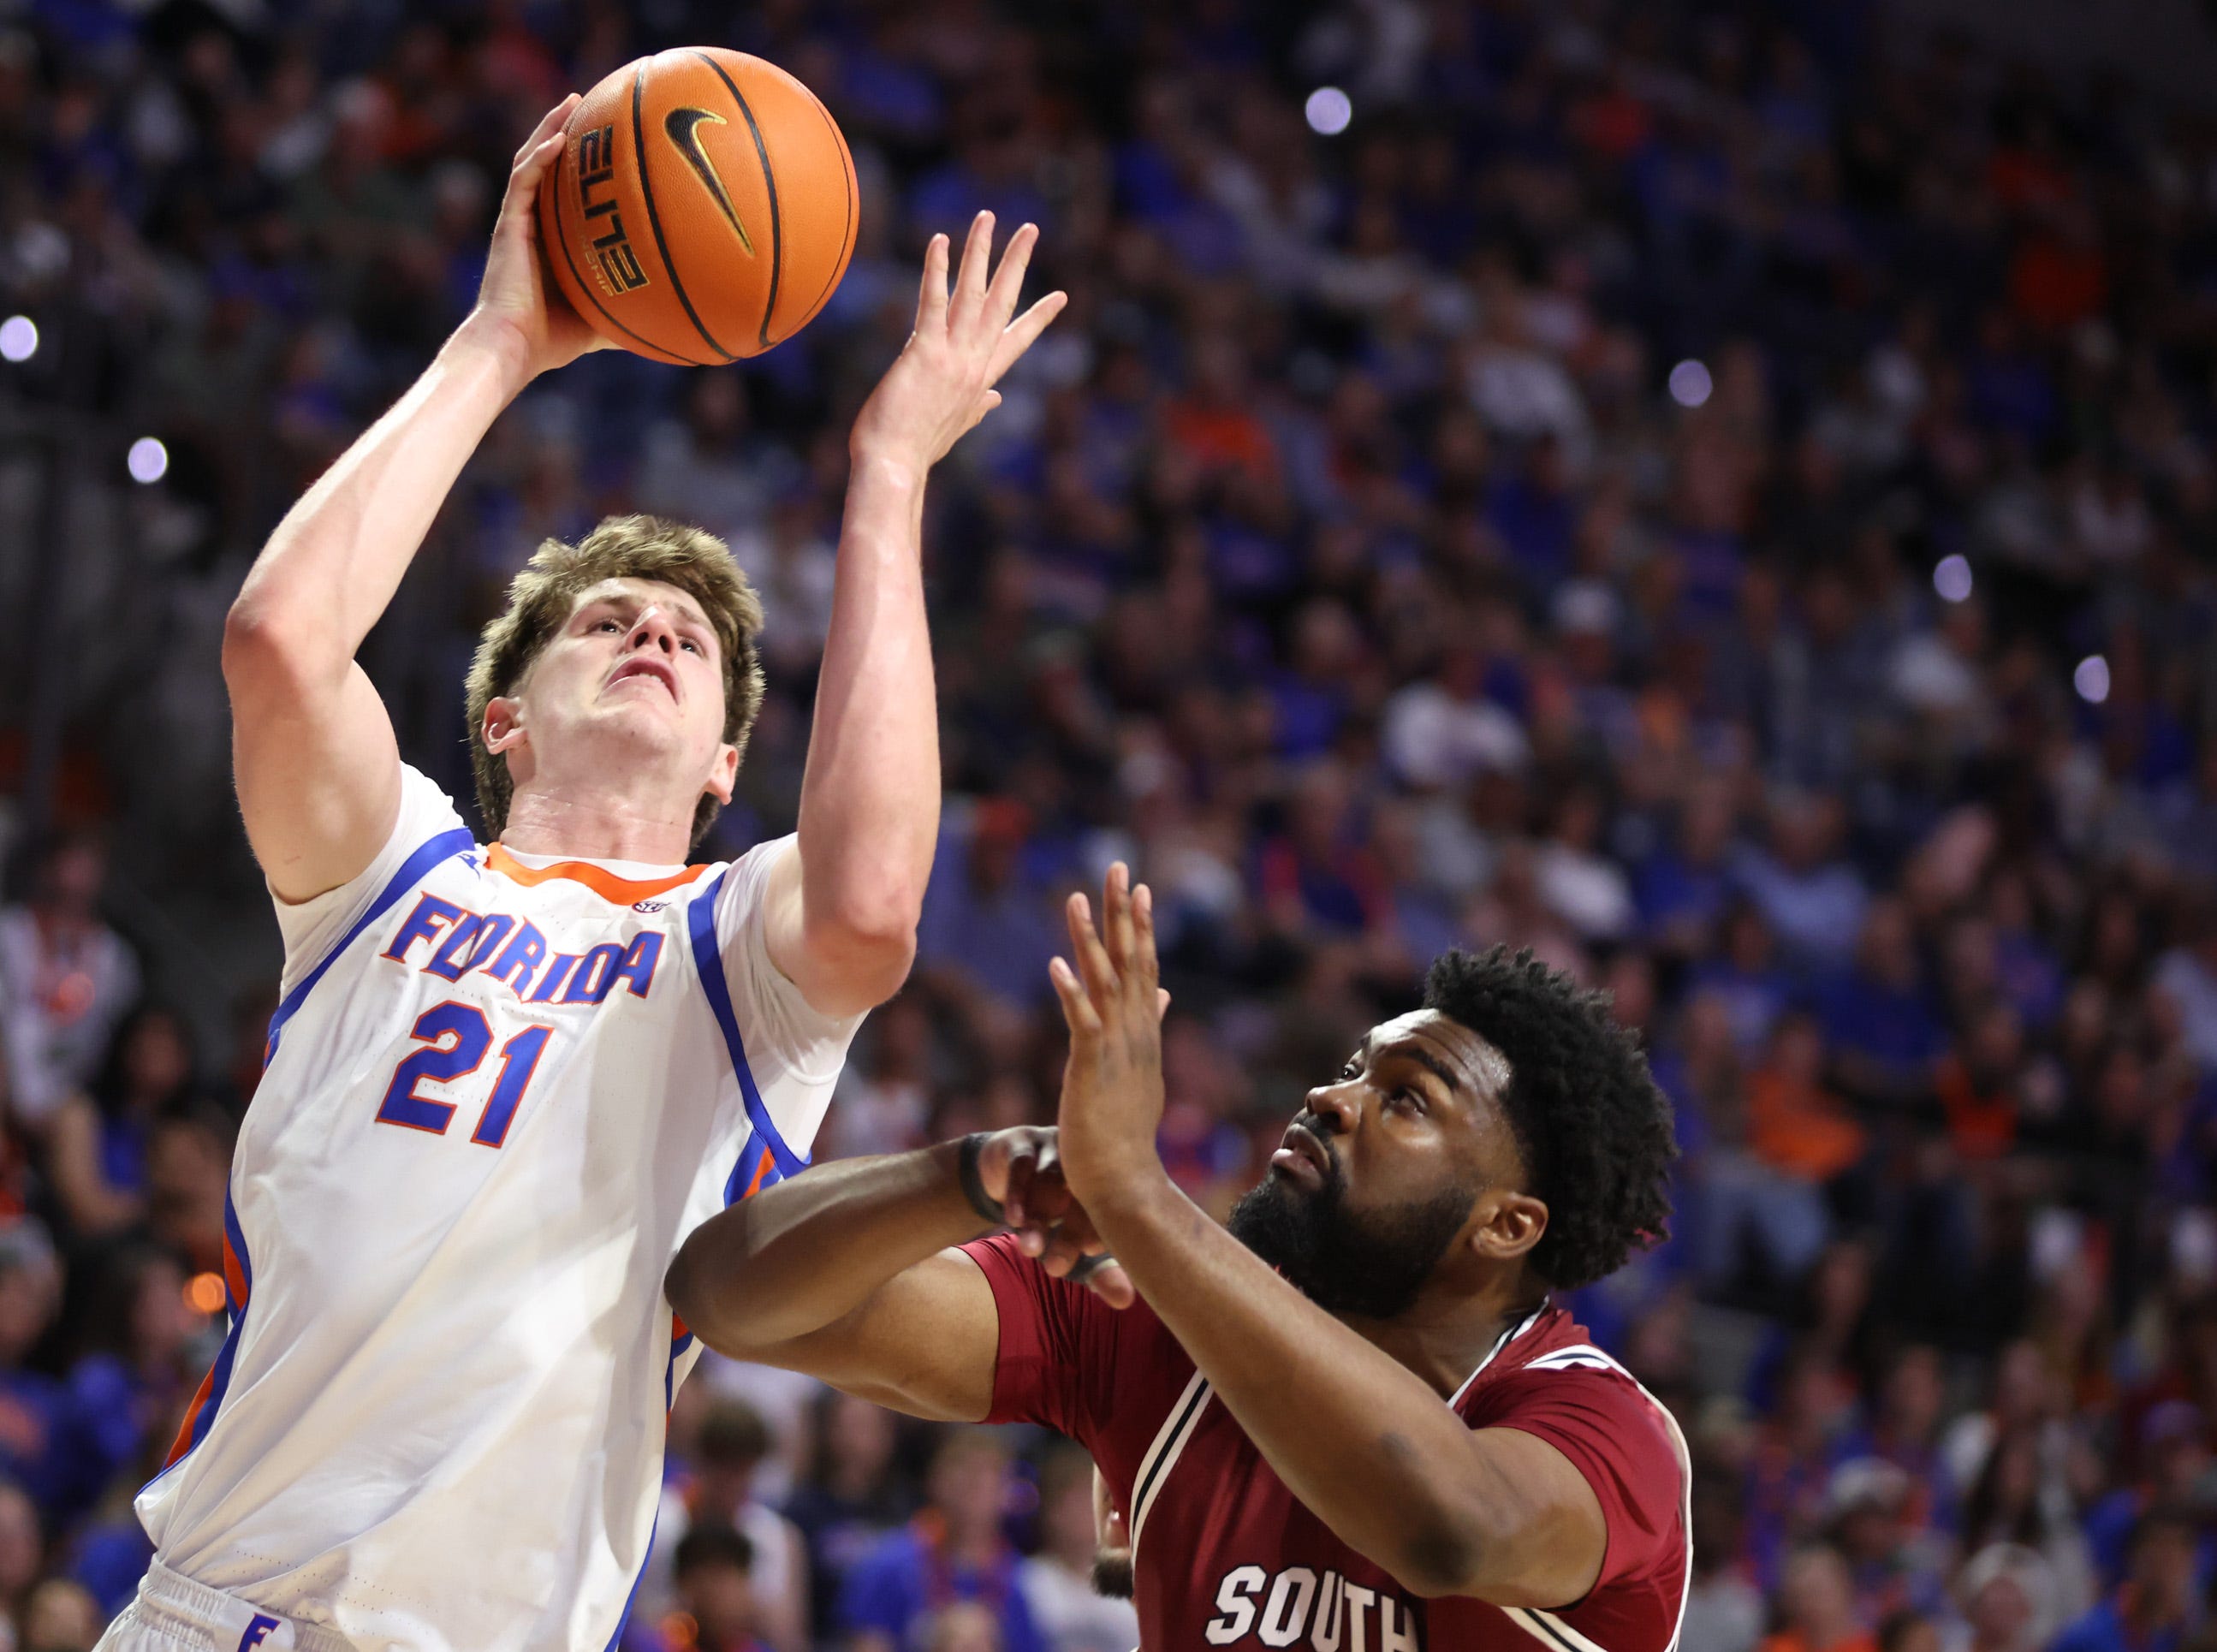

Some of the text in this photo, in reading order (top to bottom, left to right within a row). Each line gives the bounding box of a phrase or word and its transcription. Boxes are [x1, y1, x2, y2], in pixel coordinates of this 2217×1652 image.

[578, 124, 651, 295] ELITE
[379, 890, 666, 1005] FLORIDA
[375, 1000, 554, 1149] 21
[237, 1612, 281, 1652] F
[1204, 1565, 1419, 1652] SOUTH
